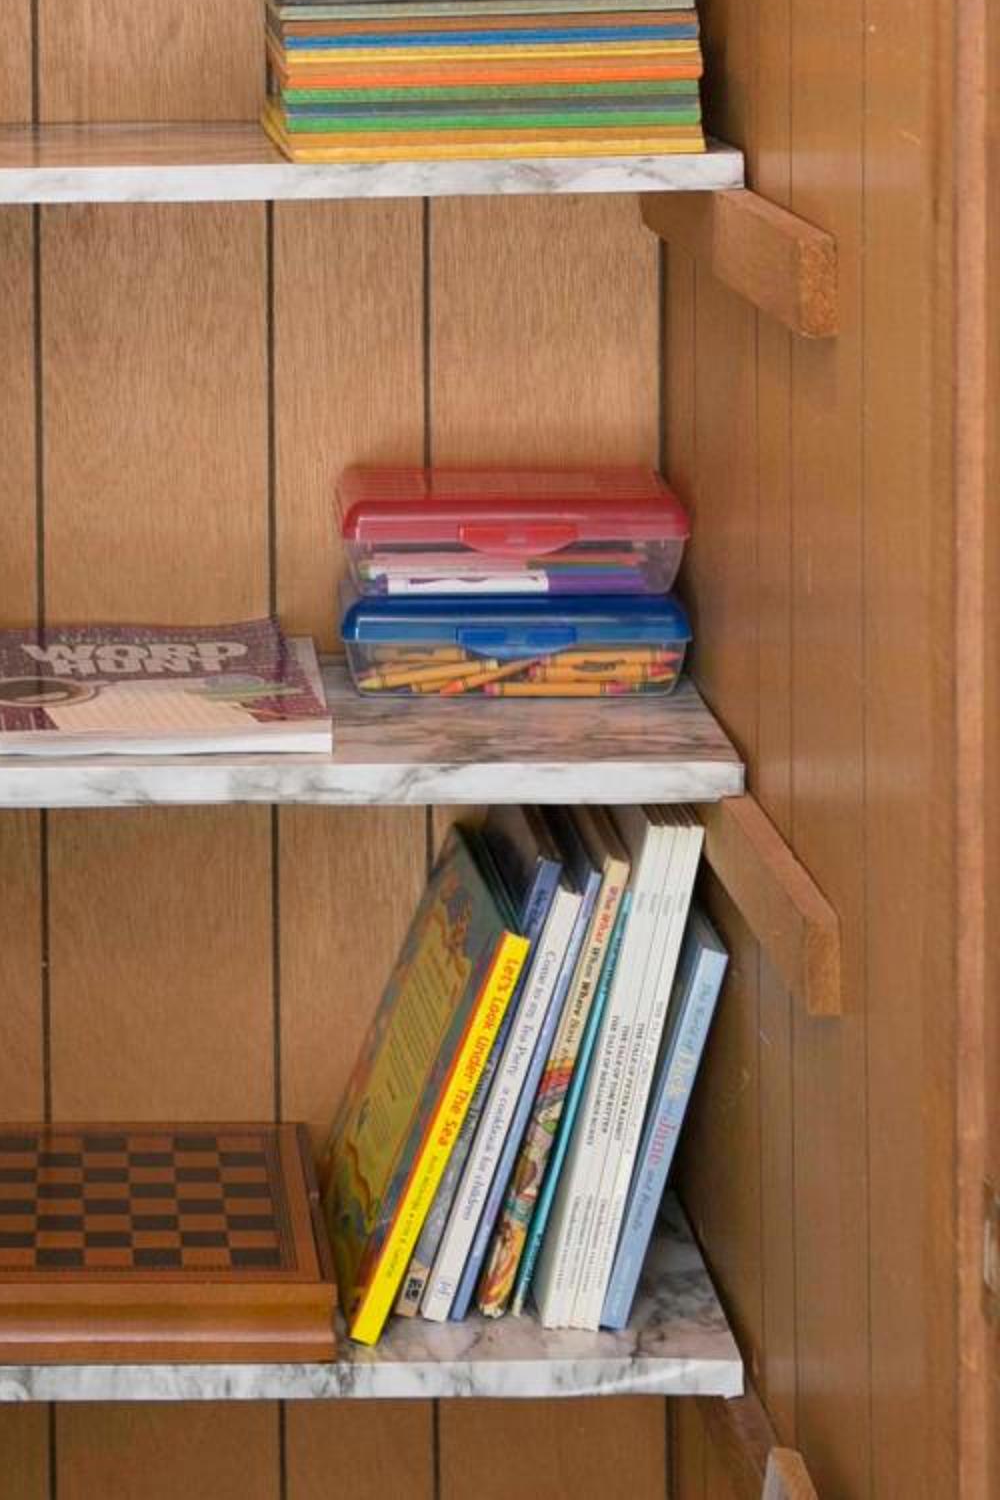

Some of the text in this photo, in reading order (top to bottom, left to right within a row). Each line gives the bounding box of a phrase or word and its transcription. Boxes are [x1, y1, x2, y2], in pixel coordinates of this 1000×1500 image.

[602, 883, 620, 911] Who
[592, 911, 611, 944] What
[495, 956, 520, 994] Let's
[582, 944, 602, 980] When
[571, 979, 592, 1017] Where
[482, 996, 505, 1031] Look
[608, 1013, 620, 1032] THE
[603, 1033, 616, 1055] TALE
[619, 1024, 630, 1042] THE
[634, 1021, 645, 1039] THE
[461, 1034, 490, 1083] Under
[505, 1043, 527, 1077] Party
[601, 1057, 611, 1069] OF
[614, 1044, 626, 1065] TALE
[629, 1041, 641, 1062] TALE
[612, 1066, 621, 1078] OF
[627, 1064, 636, 1076] OF
[448, 1087, 469, 1116] The
[607, 1081, 618, 1099] TOM
[619, 1077, 633, 1107] PETER
[435, 1117, 458, 1149] Sea
[612, 1108, 627, 1141] RABBIT
[645, 1115, 679, 1170] Jane
